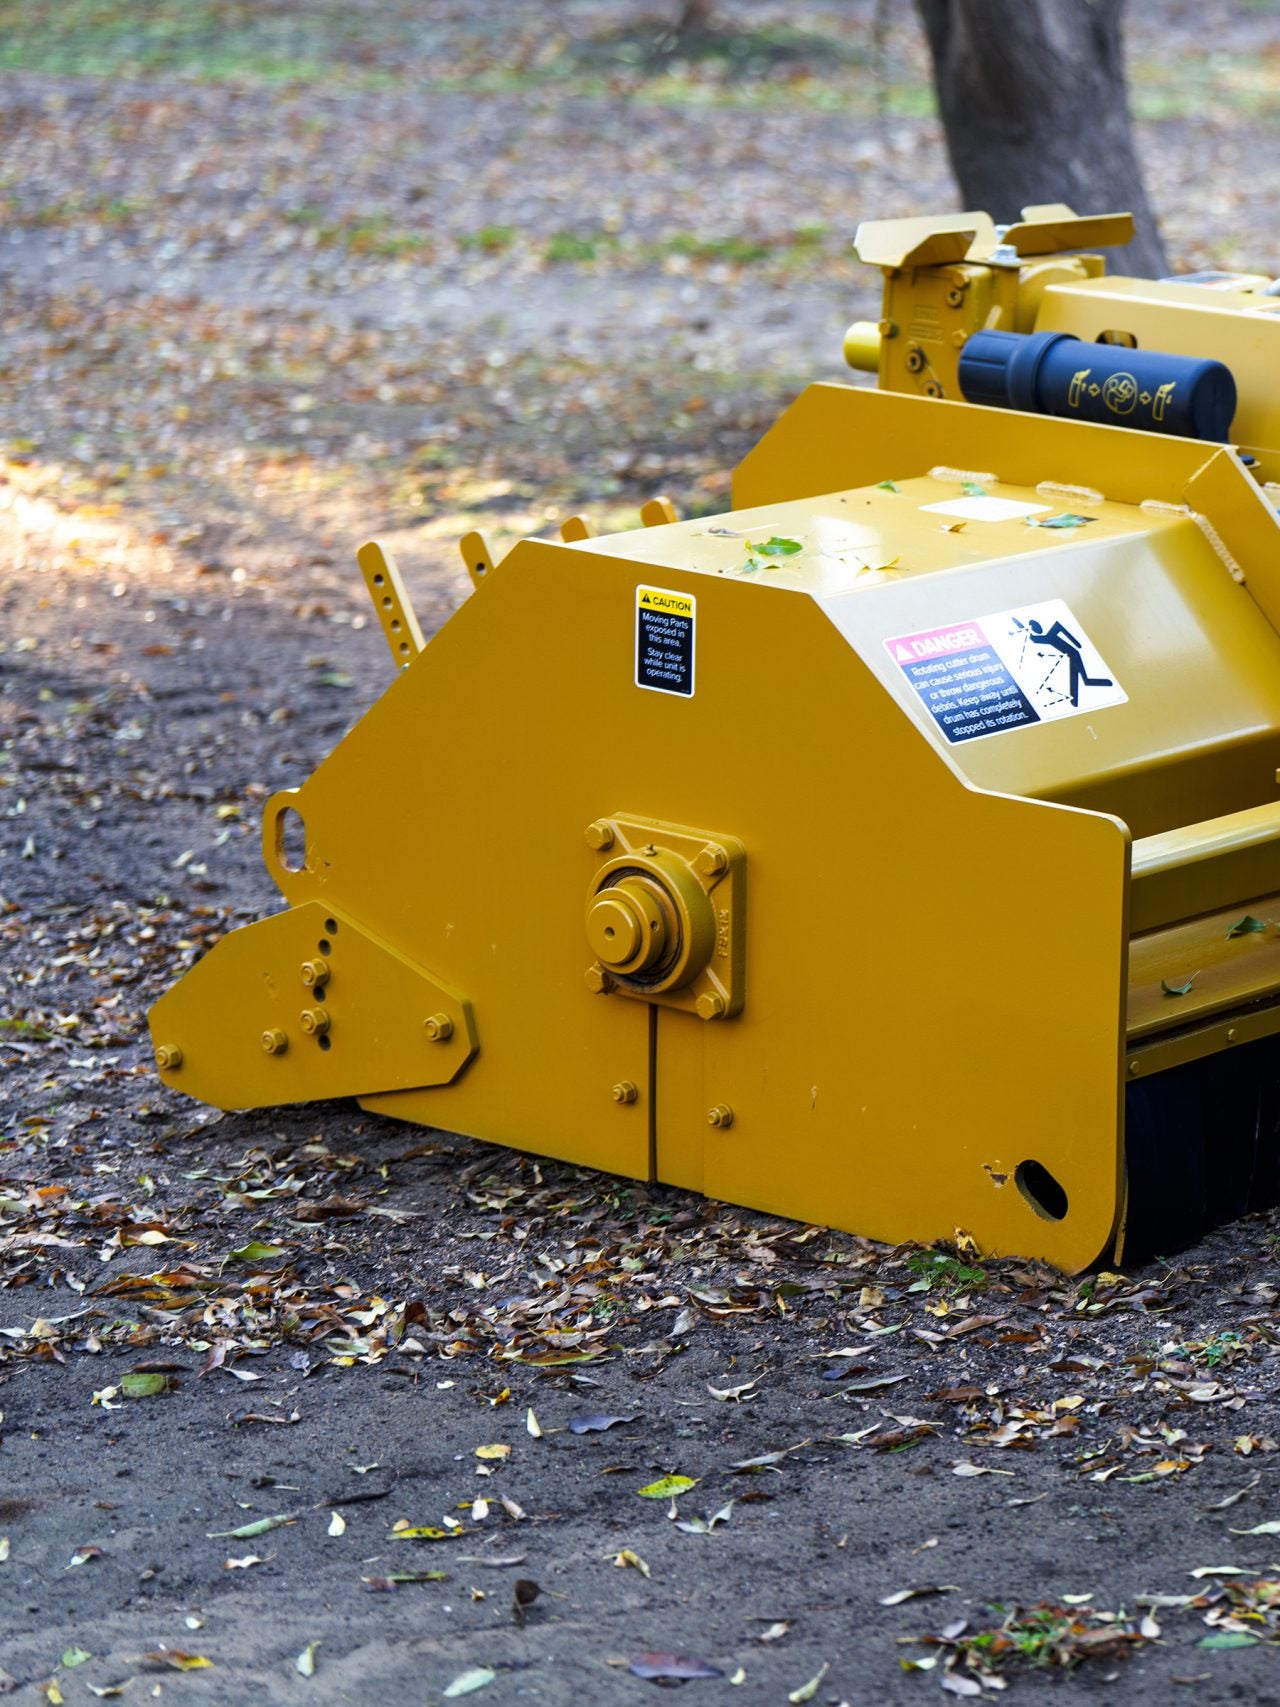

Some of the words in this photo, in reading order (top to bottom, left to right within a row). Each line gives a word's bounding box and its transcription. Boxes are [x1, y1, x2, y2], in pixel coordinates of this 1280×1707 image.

[653, 597, 691, 611] CAUTION
[642, 613, 669, 627] Moving
[670, 619, 689, 630] Parts
[645, 625, 677, 637] exposed
[677, 630, 685, 638] in
[648, 634, 662, 643] this
[663, 639, 682, 648] area.
[911, 629, 982, 657] DANGER
[643, 659, 663, 667] while
[664, 663, 678, 671] unit
[647, 648, 664, 660] Stay
[664, 653, 683, 662] clear
[911, 664, 948, 677] Rotating
[945, 658, 969, 669] cutter
[968, 652, 991, 664] drum
[646, 669, 683, 683] operating.
[914, 681, 930, 690] can
[929, 675, 954, 686] cause
[953, 669, 983, 680] serious
[981, 664, 1004, 675] injury
[929, 692, 939, 700] or
[939, 687, 962, 698] throw
[962, 677, 1005, 692] dangerous
[930, 702, 959, 713] debris.
[957, 697, 981, 707] Keep
[979, 692, 1001, 701] away
[1000, 686, 1019, 697] until
[943, 715, 964, 725] drum
[963, 710, 981, 719] has
[980, 700, 1022, 716] completely
[953, 722, 986, 736] stopped
[984, 719, 997, 728] its
[995, 713, 1029, 726] rotation.
